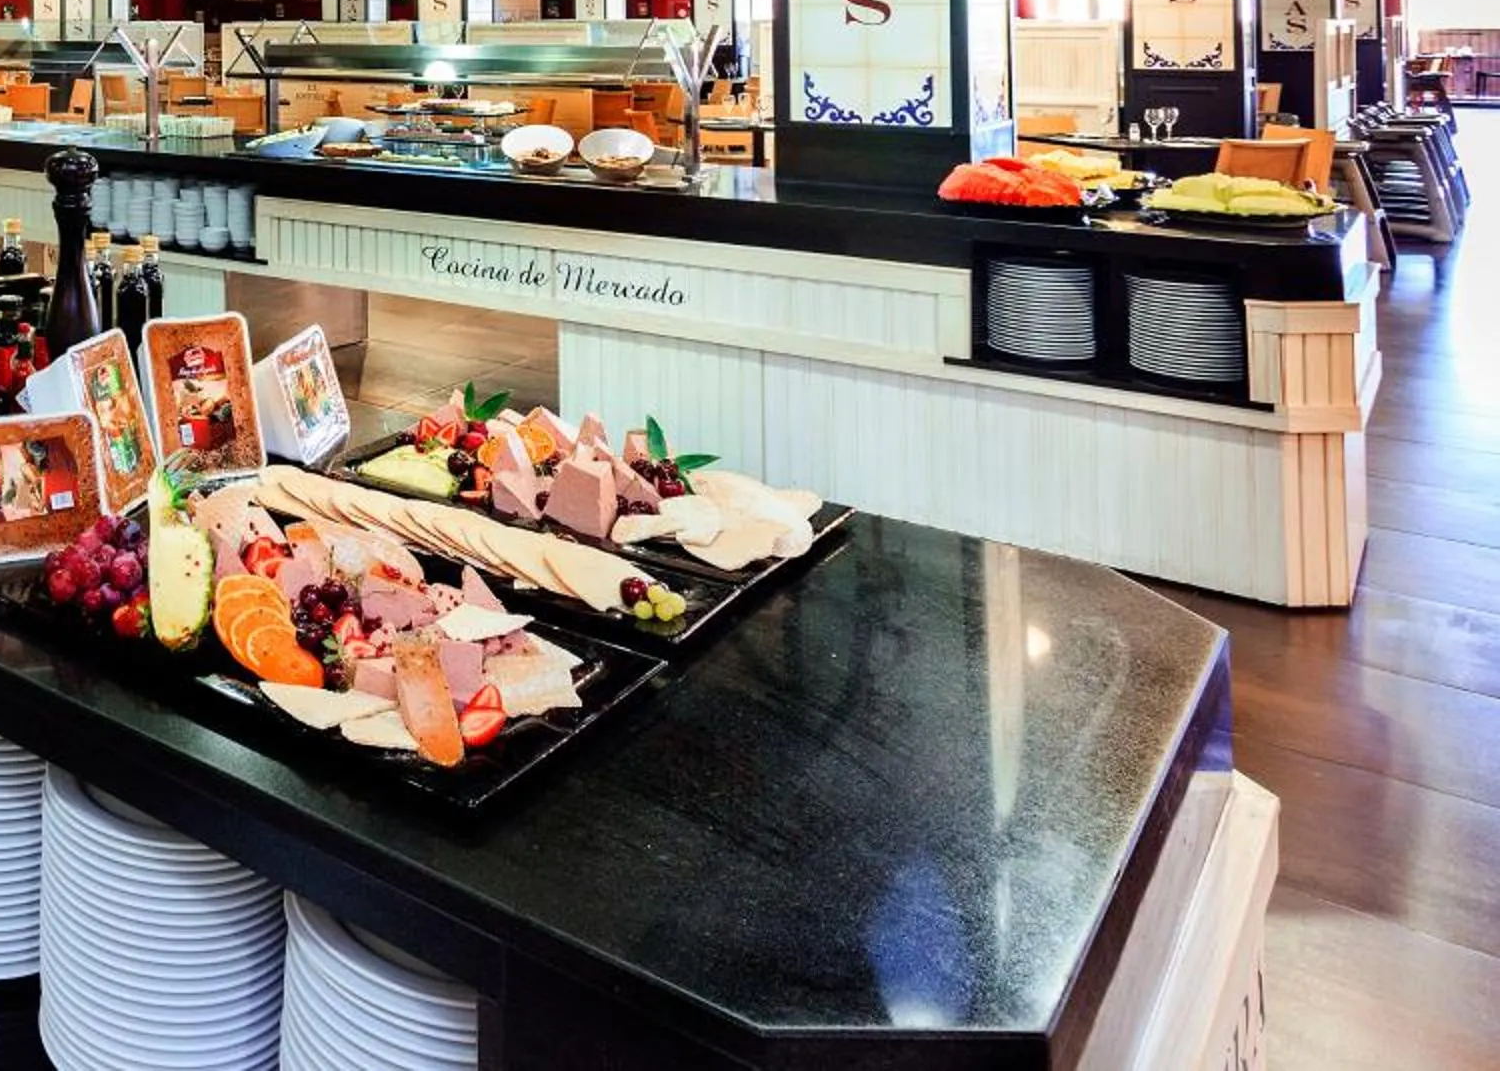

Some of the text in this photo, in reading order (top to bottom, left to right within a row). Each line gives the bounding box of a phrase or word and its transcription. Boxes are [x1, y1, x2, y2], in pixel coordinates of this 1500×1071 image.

[422, 246, 686, 306] Cocina de Mercado
